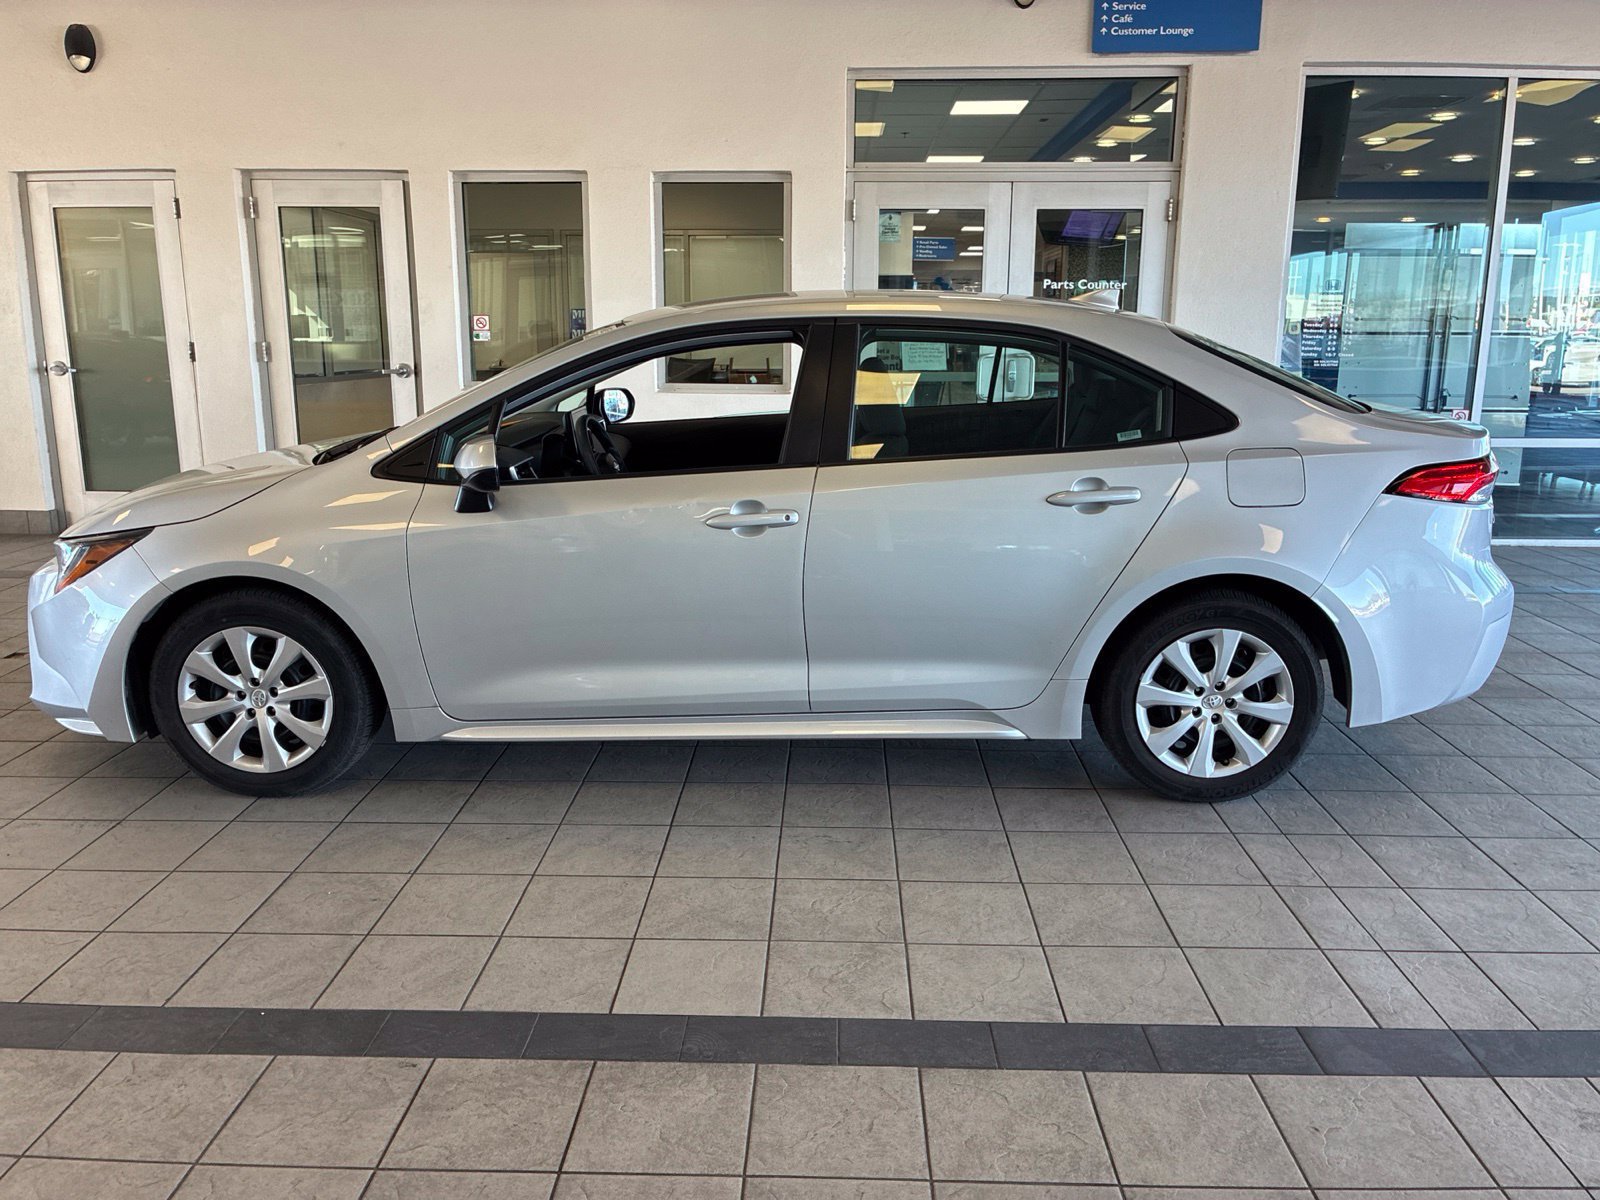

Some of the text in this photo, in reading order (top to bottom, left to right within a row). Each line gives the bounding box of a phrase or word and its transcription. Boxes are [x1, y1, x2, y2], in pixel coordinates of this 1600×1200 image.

[1112, 2, 1147, 11] Service
[1112, 14, 1133, 23] Café
[1111, 26, 1194, 36] Customer Lounge
[1043, 279, 1127, 289] Parts Counter
